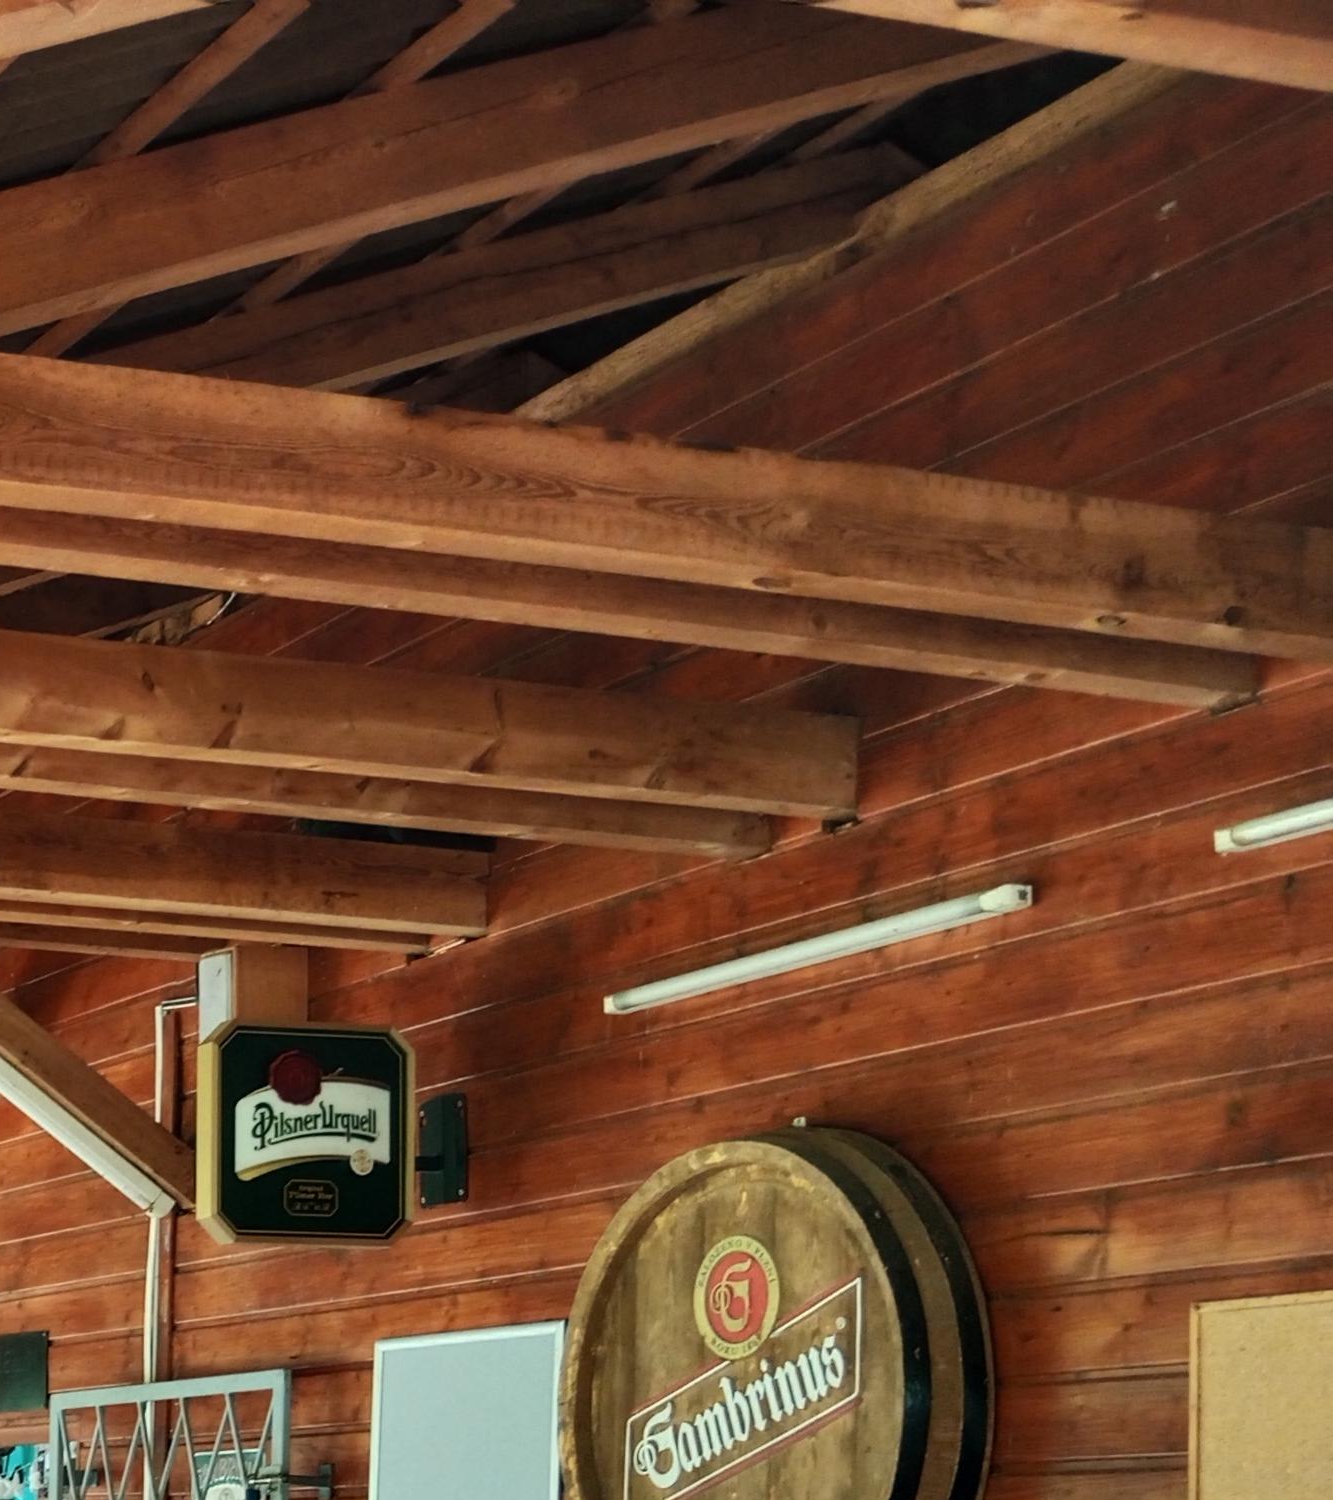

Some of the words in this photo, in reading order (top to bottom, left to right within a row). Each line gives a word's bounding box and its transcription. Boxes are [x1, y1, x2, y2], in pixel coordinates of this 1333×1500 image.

[251, 1101, 322, 1151] Pilsner
[319, 1101, 377, 1143] Urquell
[633, 1334, 846, 1489] Gambrinus
